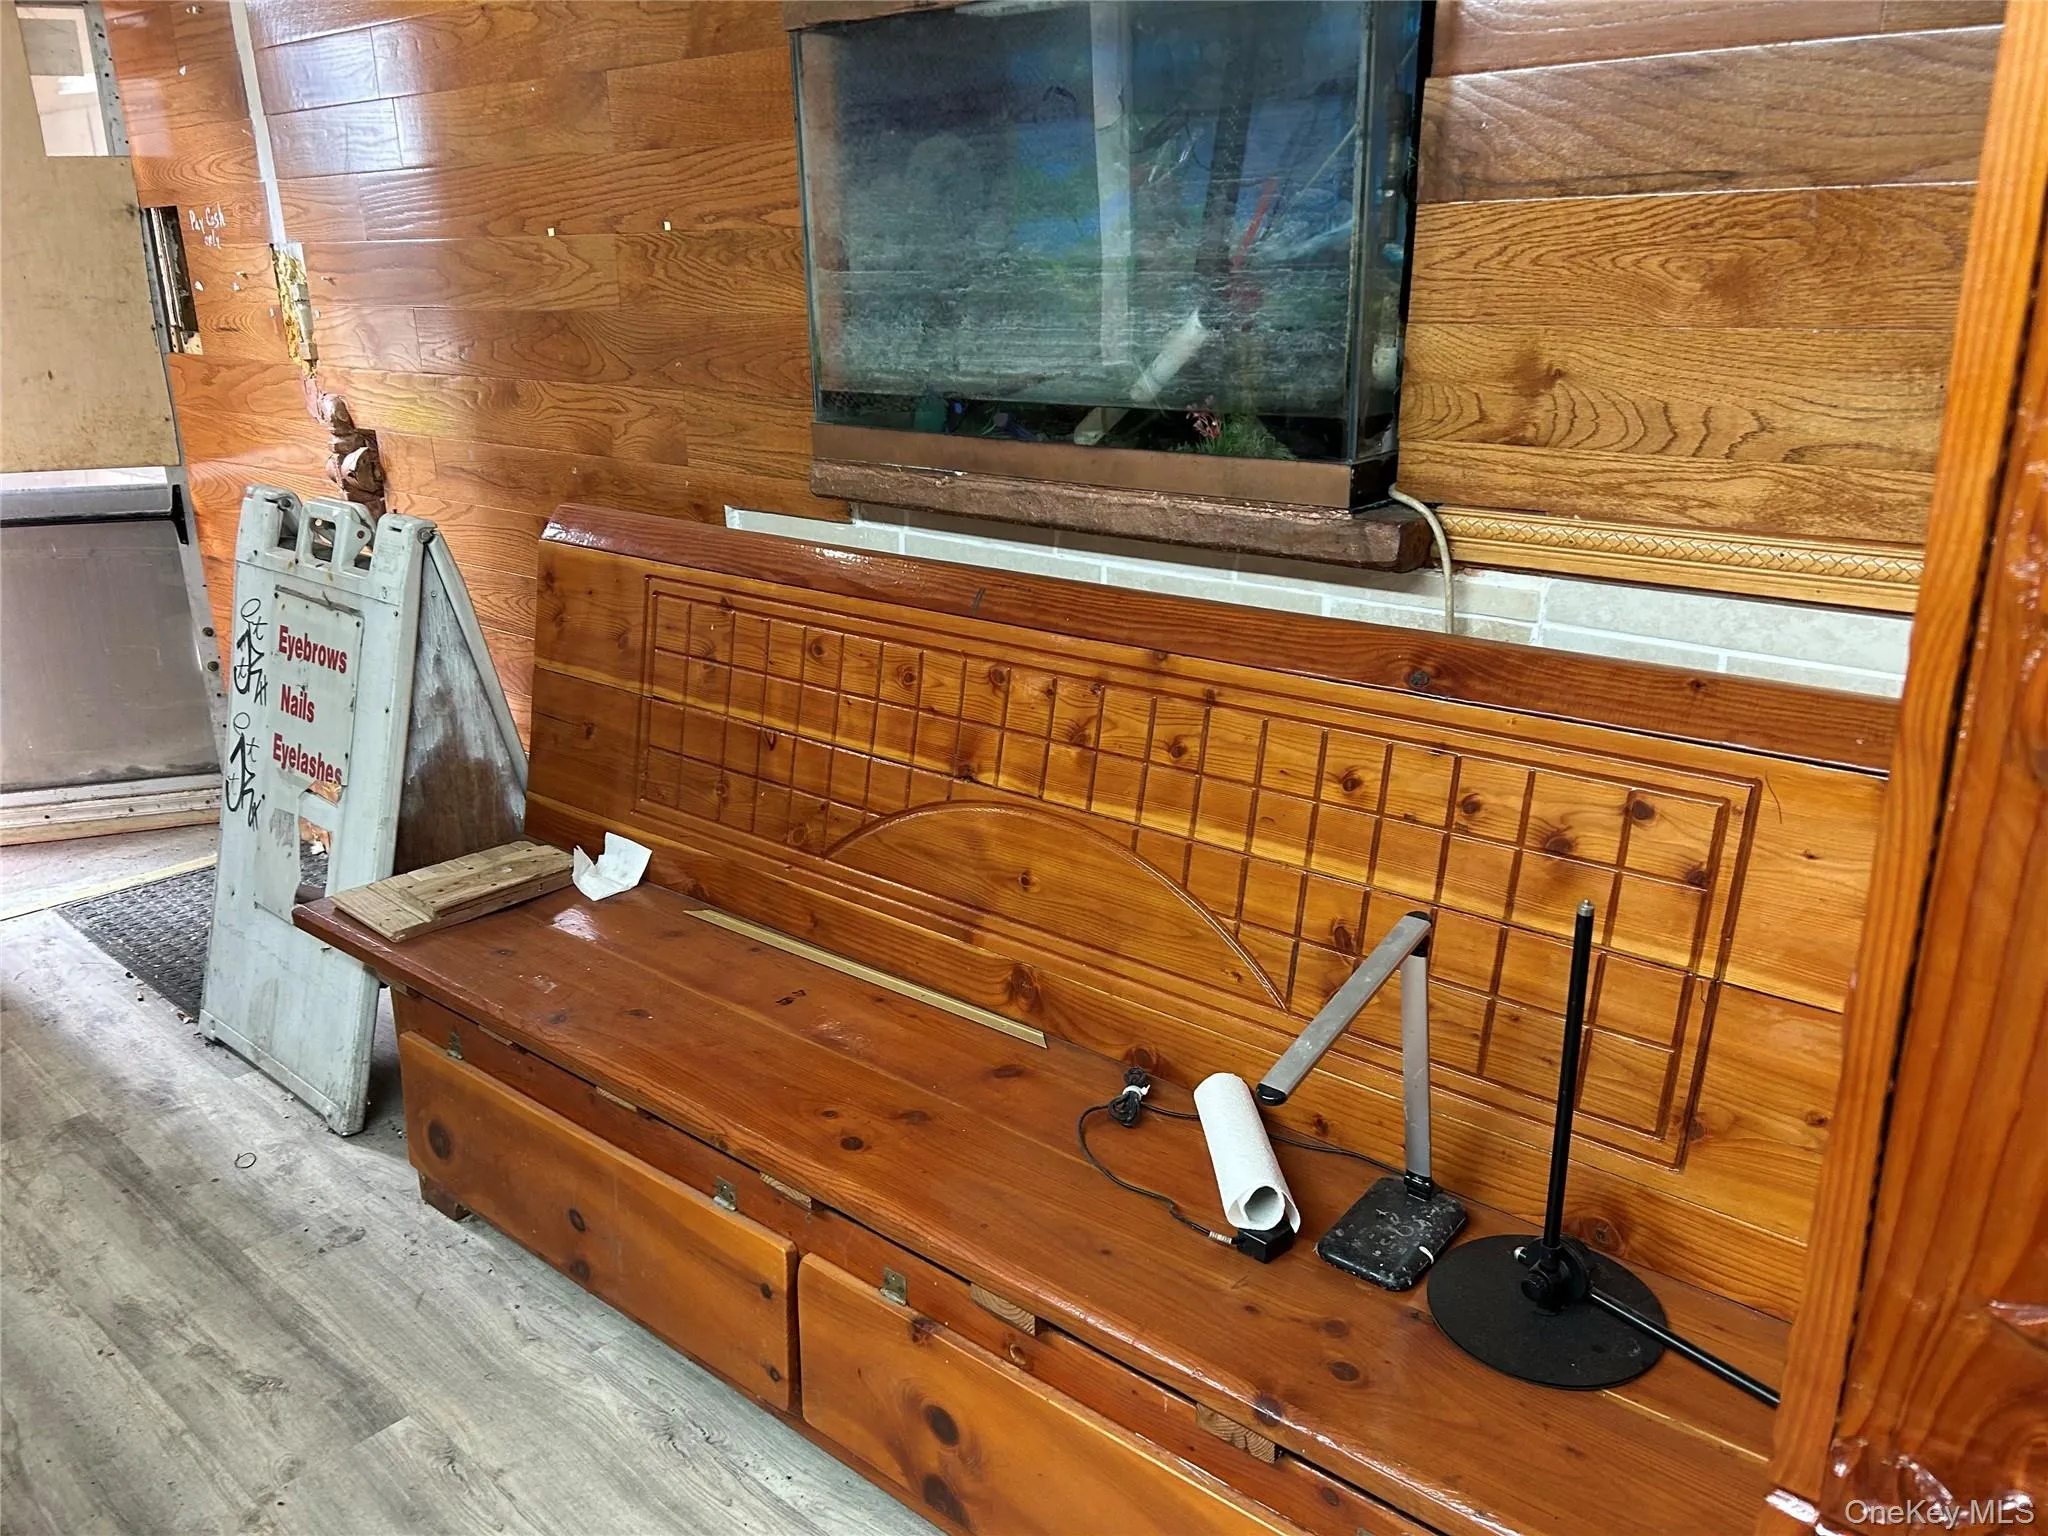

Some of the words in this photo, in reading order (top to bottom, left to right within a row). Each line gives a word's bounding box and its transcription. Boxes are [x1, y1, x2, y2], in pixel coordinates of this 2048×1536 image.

[188, 209, 206, 234] Pay
[205, 201, 226, 229] Cash
[278, 625, 348, 674] Eyebrows
[280, 684, 315, 723] Nails
[272, 732, 343, 786] Eyelashes
